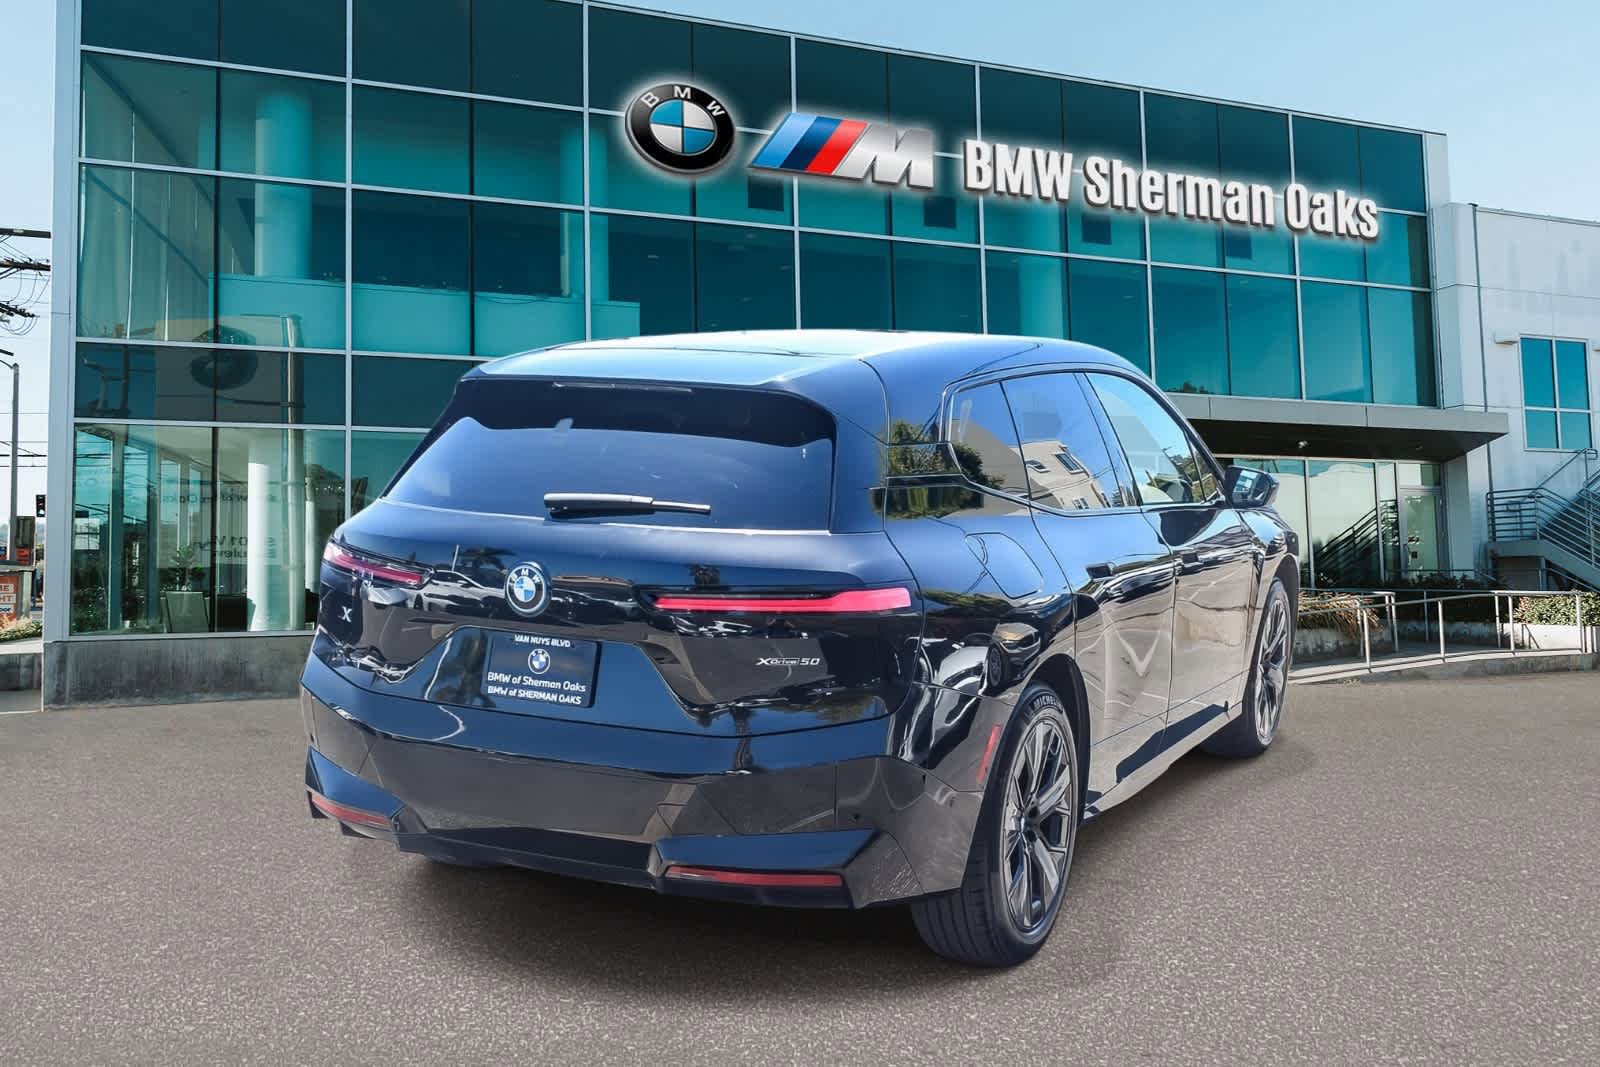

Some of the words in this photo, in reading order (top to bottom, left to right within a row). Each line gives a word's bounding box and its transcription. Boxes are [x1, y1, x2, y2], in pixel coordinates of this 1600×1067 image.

[641, 85, 726, 117] BMW
[963, 139, 1073, 202] BMW
[1083, 155, 1275, 227] Sherman
[1284, 183, 1379, 242] Oaks
[510, 568, 541, 584] BMW
[514, 634, 529, 642] VAN
[530, 636, 550, 645] NUYS
[550, 638, 571, 648] BLVD
[487, 671, 511, 683] BMW
[511, 676, 521, 684] of
[522, 676, 561, 689] Sherman
[562, 680, 586, 692] Oaks
[487, 685, 508, 696] BMW
[508, 689, 516, 697] of
[517, 689, 558, 702] SHERMAN
[558, 694, 582, 705] OAKS
